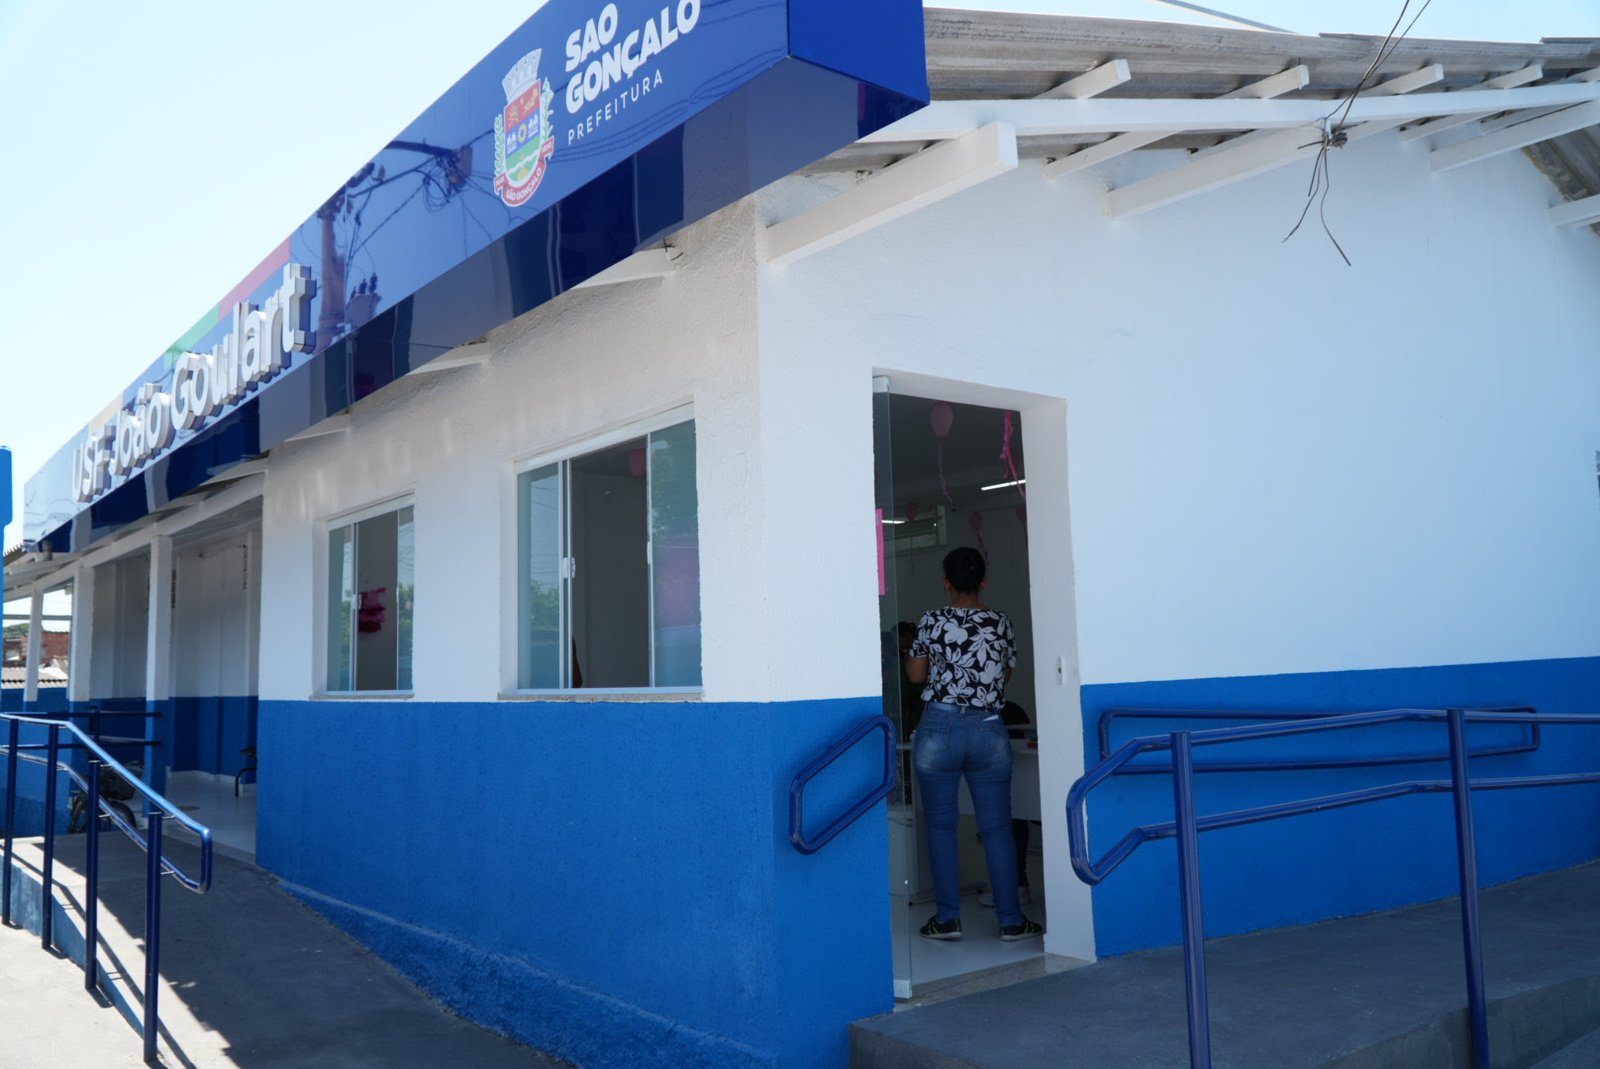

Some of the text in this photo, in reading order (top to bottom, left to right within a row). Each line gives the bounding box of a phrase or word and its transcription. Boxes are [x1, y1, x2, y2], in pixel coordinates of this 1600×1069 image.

[565, 0, 701, 114] GONÇALO
[567, 69, 663, 146] PREFEITURA
[72, 263, 315, 502] USF João Goulart
